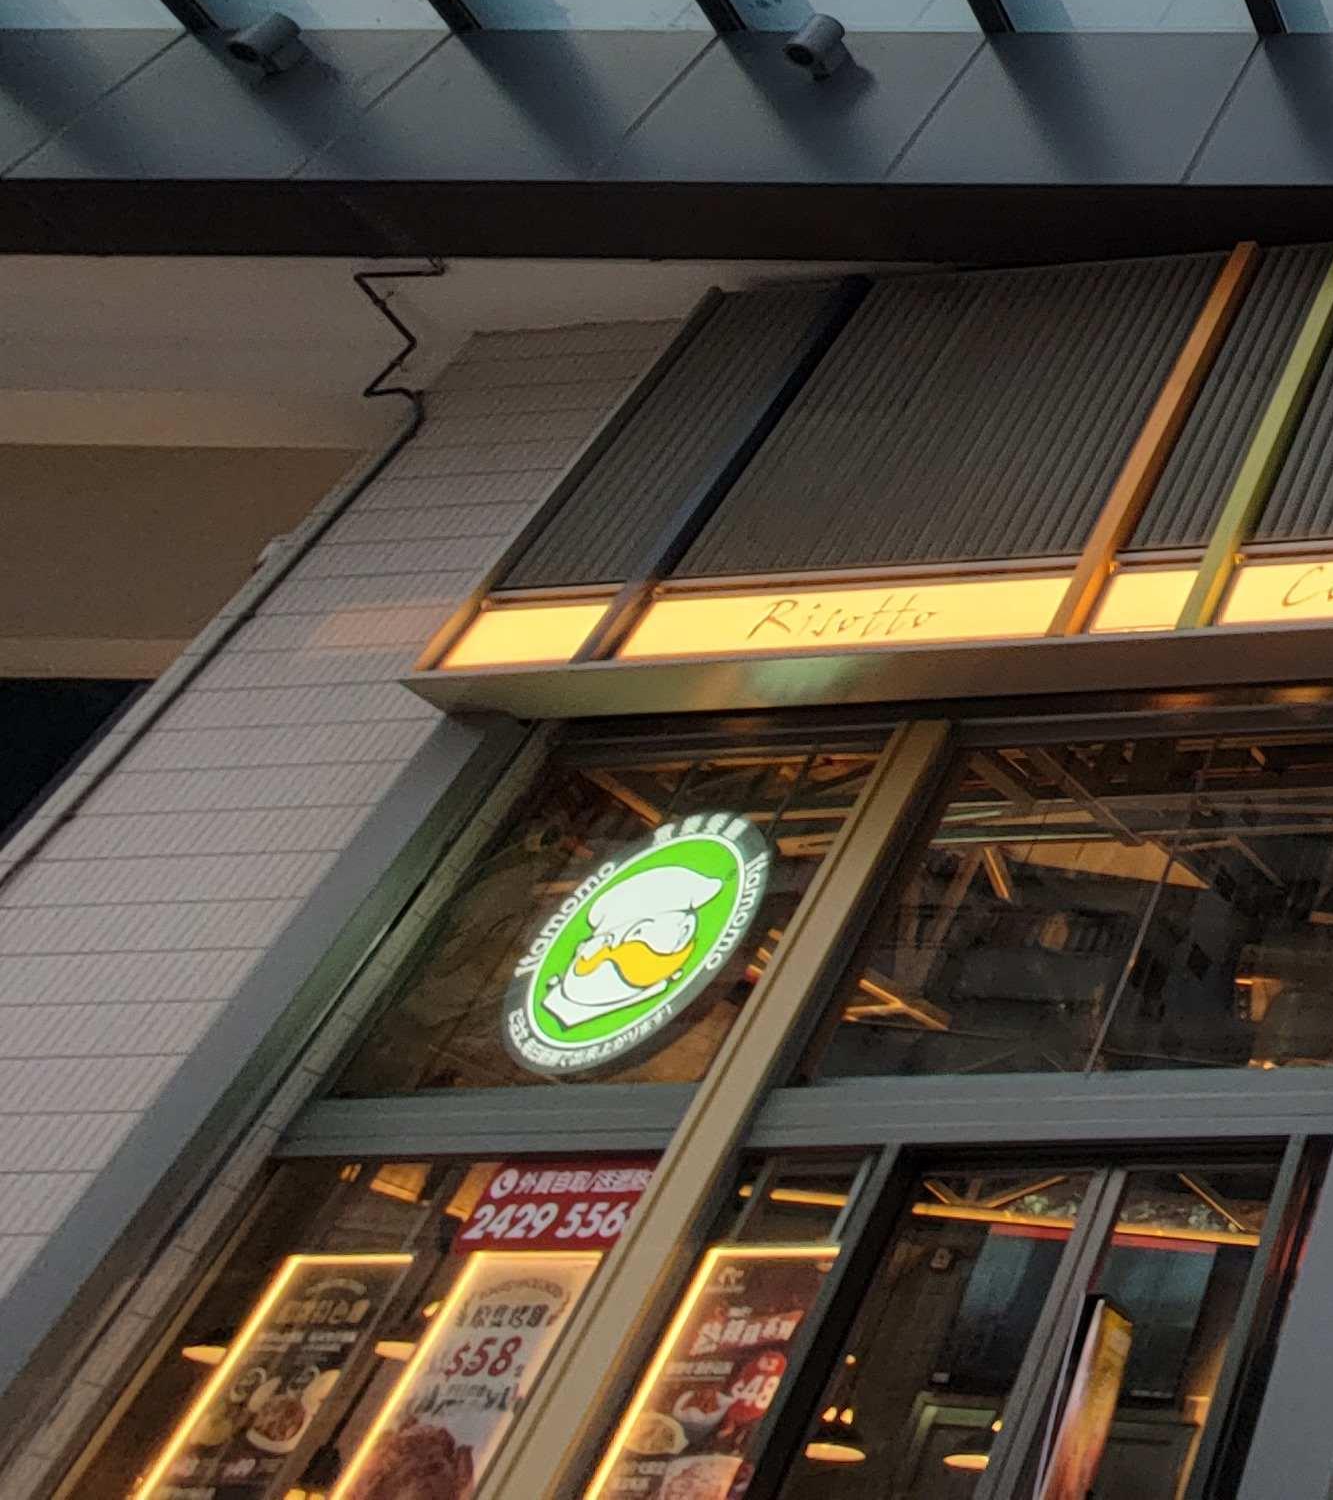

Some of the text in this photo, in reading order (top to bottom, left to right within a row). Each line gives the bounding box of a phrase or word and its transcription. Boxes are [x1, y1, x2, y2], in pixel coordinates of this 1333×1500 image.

[747, 593, 941, 640] Risotto
[513, 861, 617, 978] Itamomo
[702, 851, 769, 971] Itamomo
[462, 1201, 633, 1240] 2429 556
[445, 1335, 523, 1382] $58
